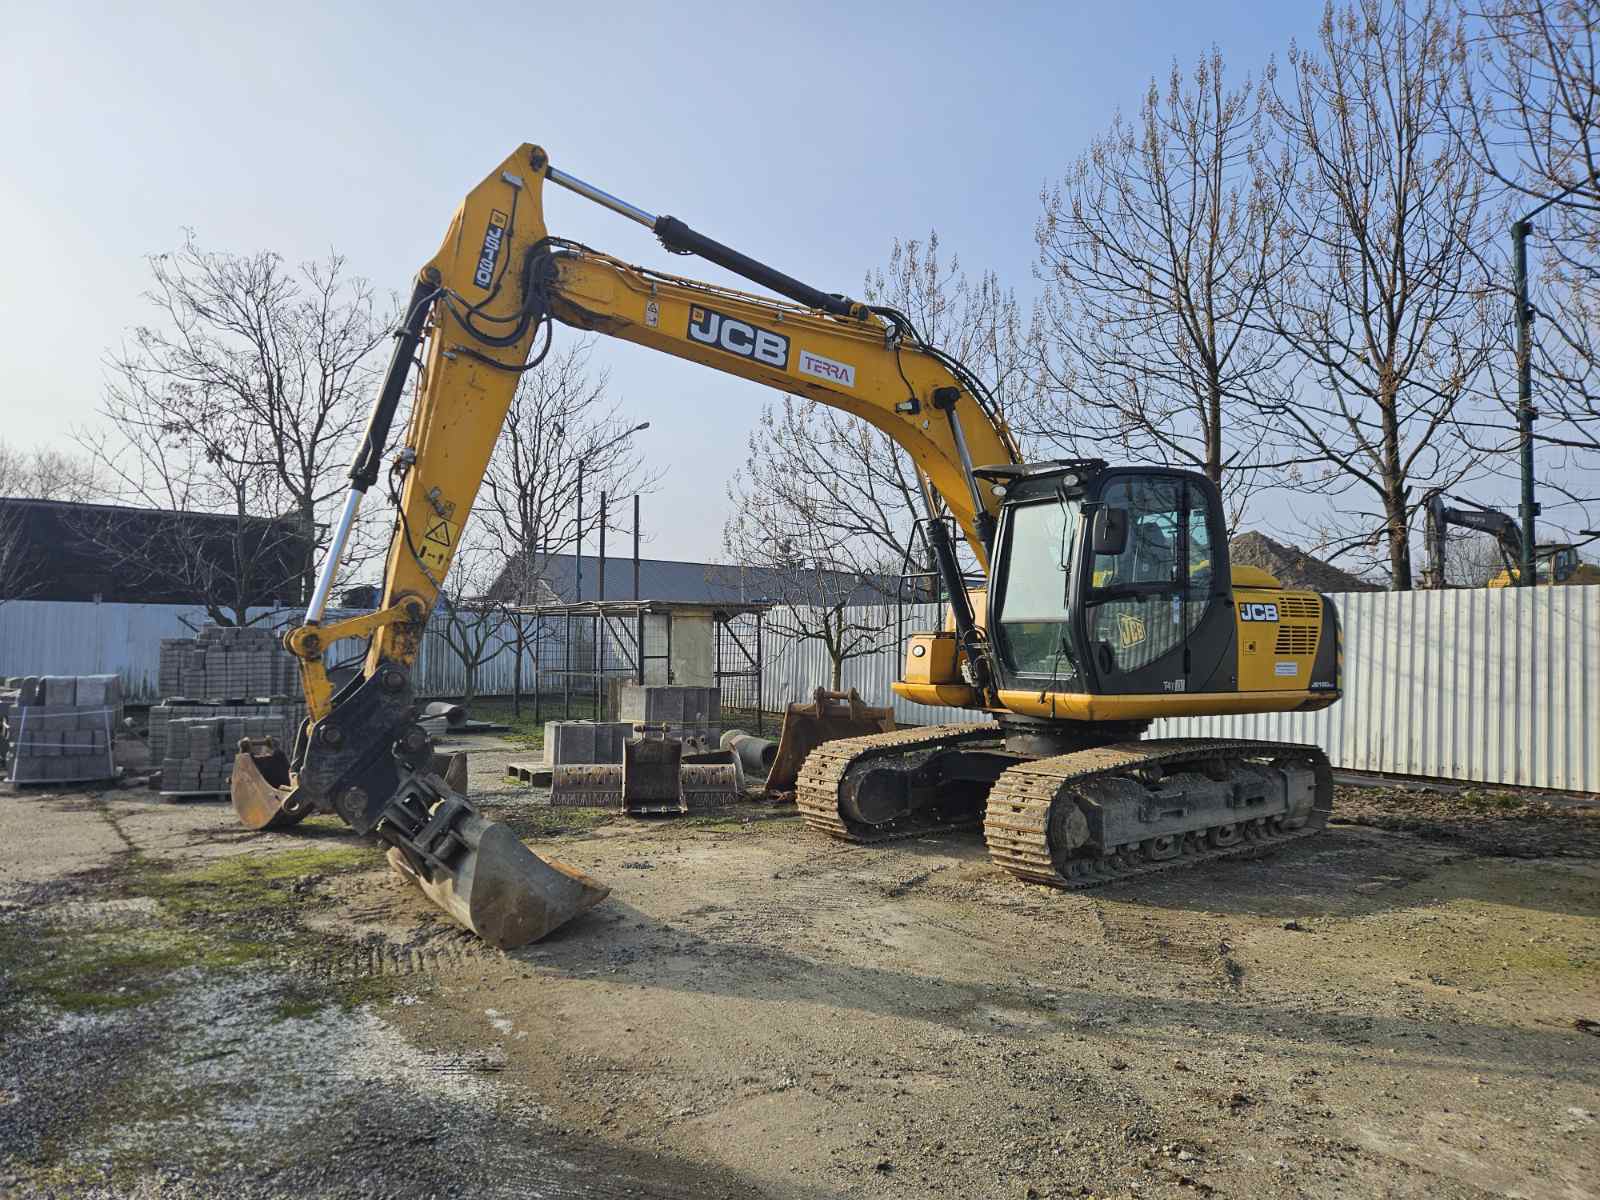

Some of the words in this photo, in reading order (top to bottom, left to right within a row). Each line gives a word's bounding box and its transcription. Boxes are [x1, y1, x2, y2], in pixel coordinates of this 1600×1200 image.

[690, 312, 787, 367] JCB
[804, 356, 850, 383] TERRA
[1241, 604, 1278, 621] JCB
[1120, 617, 1144, 644] JCB
